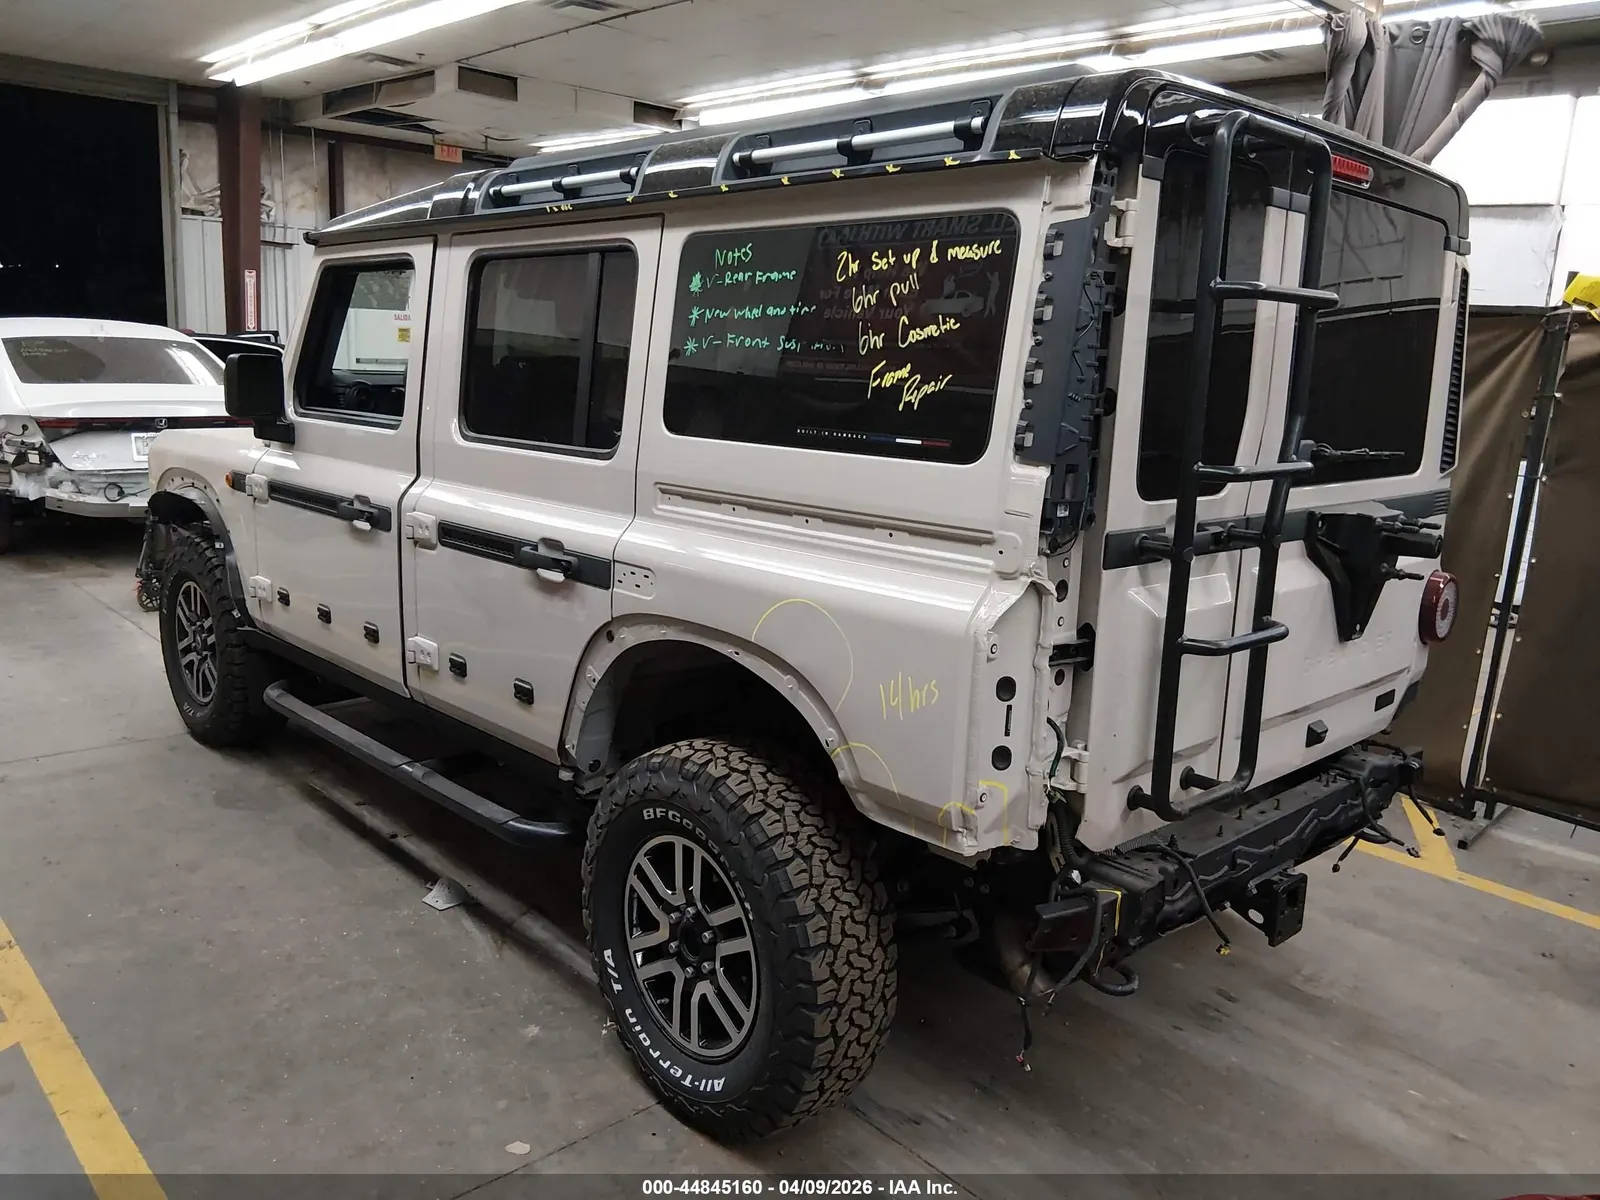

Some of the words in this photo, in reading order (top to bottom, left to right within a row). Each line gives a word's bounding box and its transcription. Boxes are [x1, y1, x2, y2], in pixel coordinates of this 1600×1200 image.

[715, 243, 752, 269] Notes
[836, 250, 860, 282] 2hr
[903, 248, 920, 269] up
[947, 239, 1002, 261] measure
[889, 272, 920, 307] pull
[898, 314, 960, 348] Cosmetic
[603, 948, 623, 995] T/A
